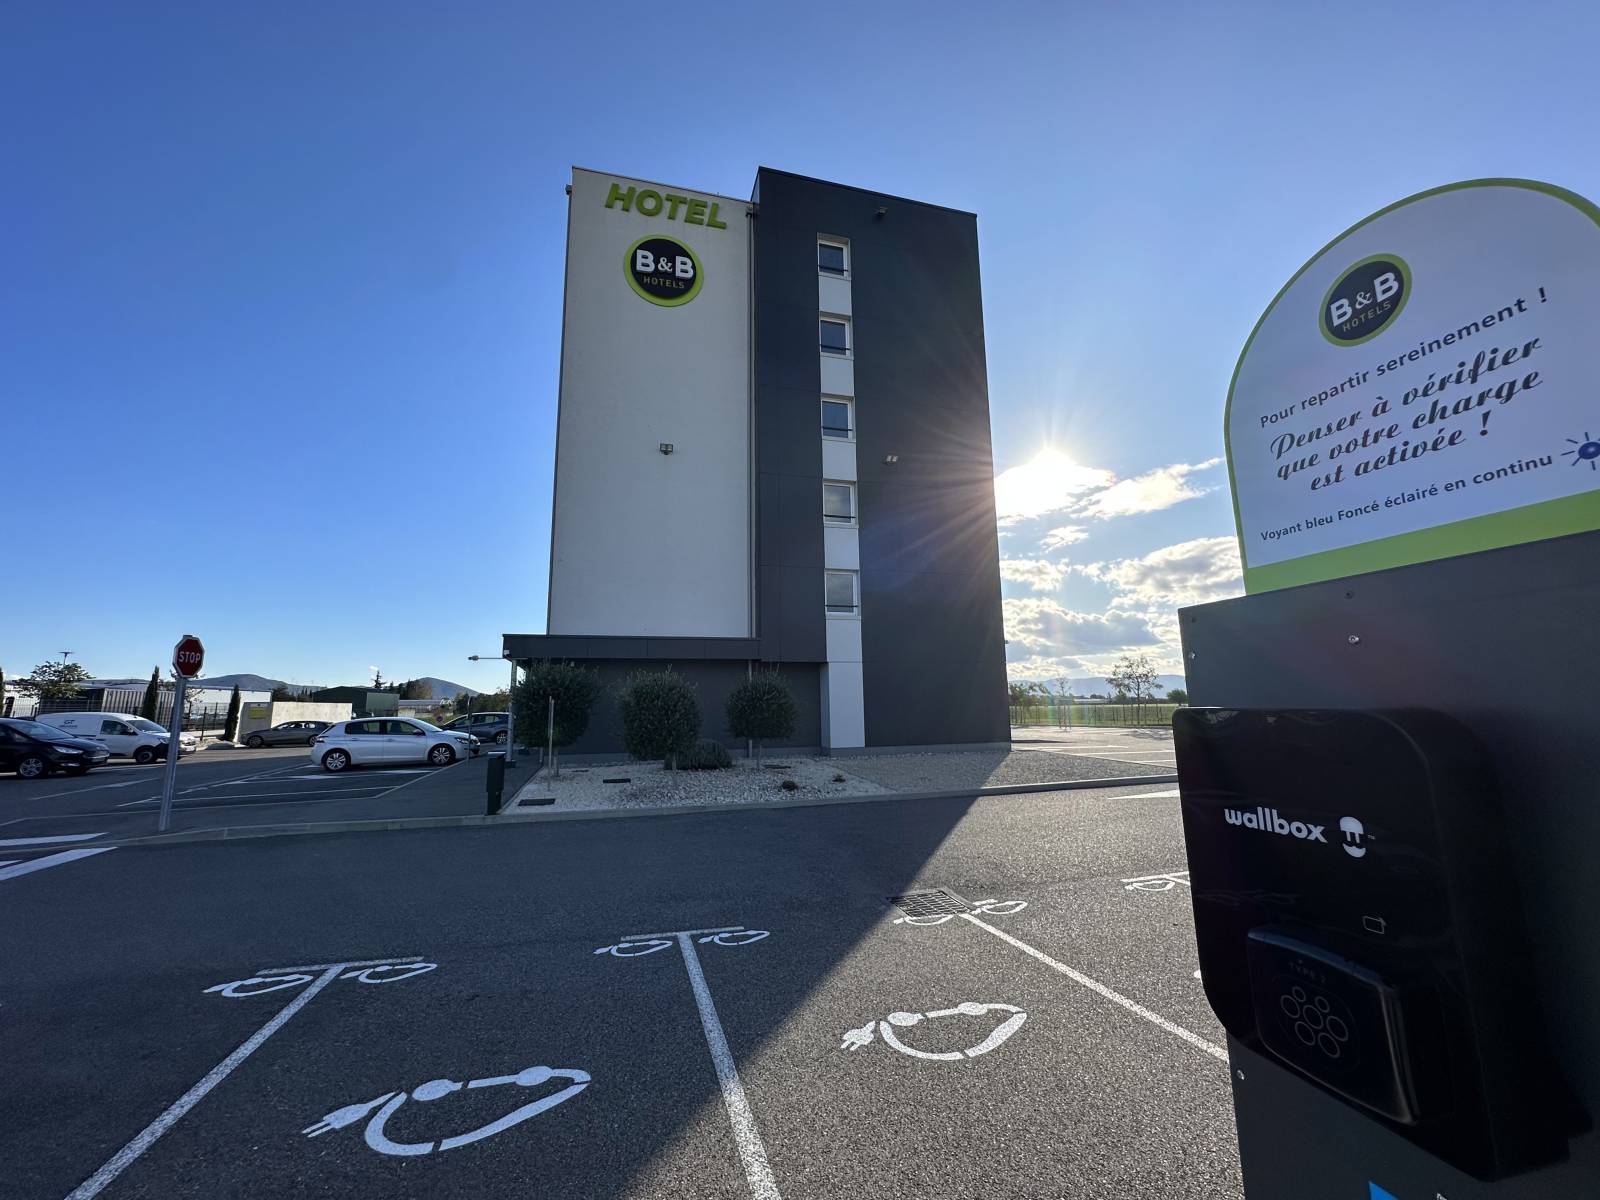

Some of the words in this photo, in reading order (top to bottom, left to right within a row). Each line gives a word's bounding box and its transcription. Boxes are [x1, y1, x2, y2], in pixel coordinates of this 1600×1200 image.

[604, 182, 727, 230] HOTEL
[643, 275, 685, 289] HOTELS
[1342, 301, 1391, 332] HOTELS
[1260, 404, 1296, 429] Pour
[1301, 370, 1369, 411] repartir
[1376, 298, 1528, 377] sereinement
[1270, 411, 1362, 460] Penser
[1372, 396, 1392, 417] à
[1402, 338, 1542, 406] vérifier
[1277, 453, 1320, 480] que
[1329, 423, 1402, 460] votre
[1412, 371, 1543, 430] charge
[1310, 464, 1346, 491] est
[1354, 427, 1466, 477] activée
[1260, 522, 1302, 541] Voyant
[1305, 516, 1333, 530] bleu
[1338, 500, 1380, 521] Foncé
[1384, 483, 1438, 509] éclairé
[1444, 478, 1466, 493] en
[1473, 455, 1553, 484] continu
[178, 650, 201, 664] STOP
[1224, 806, 1329, 844] wallbox
